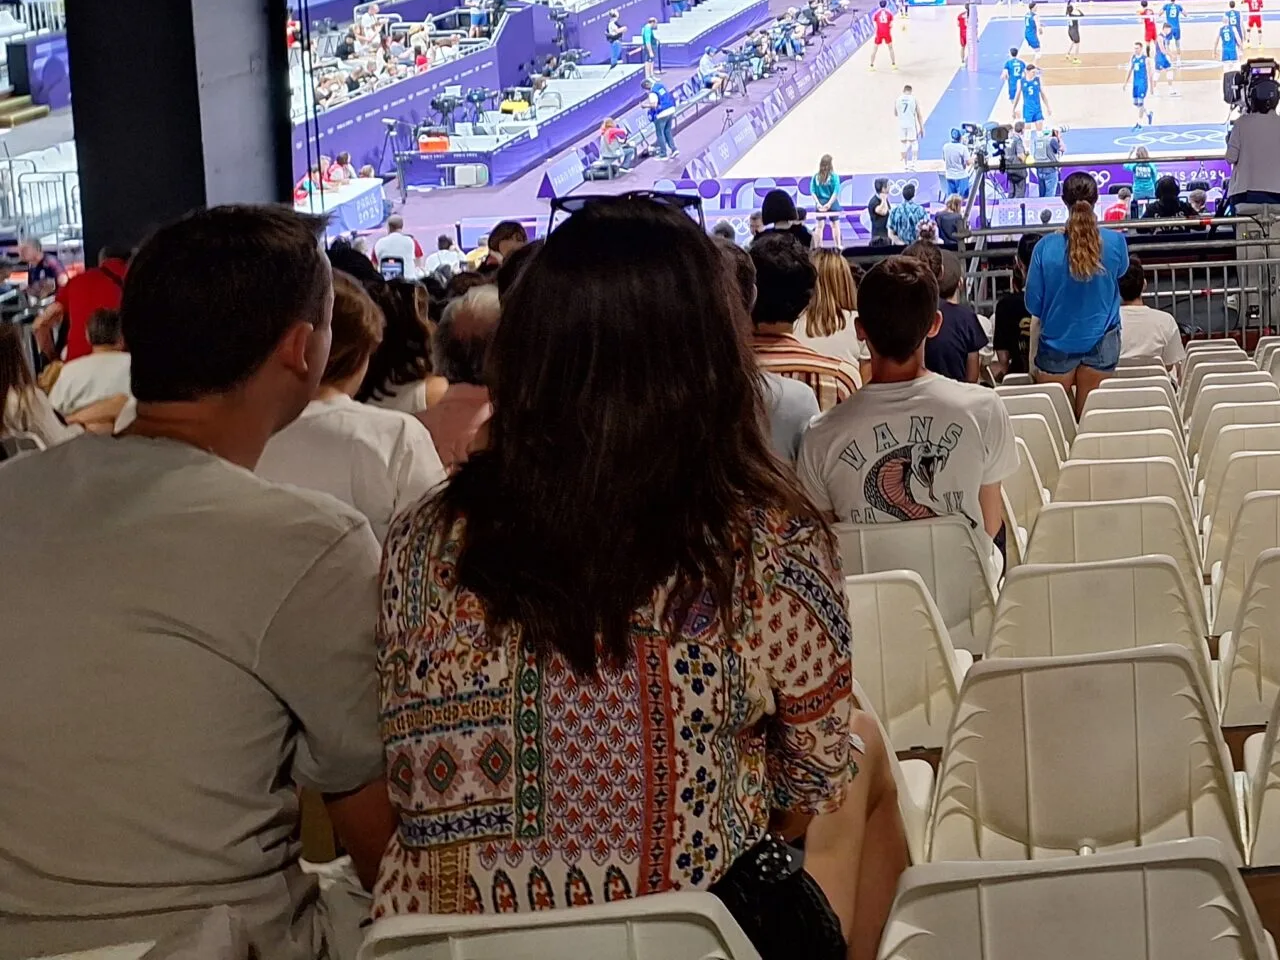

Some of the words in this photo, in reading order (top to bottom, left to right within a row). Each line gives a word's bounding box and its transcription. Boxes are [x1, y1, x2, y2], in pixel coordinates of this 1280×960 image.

[1028, 85, 1034, 96] 5
[901, 102, 909, 113] 7
[1190, 169, 1226, 181] 2024
[838, 416, 963, 472] VANS
